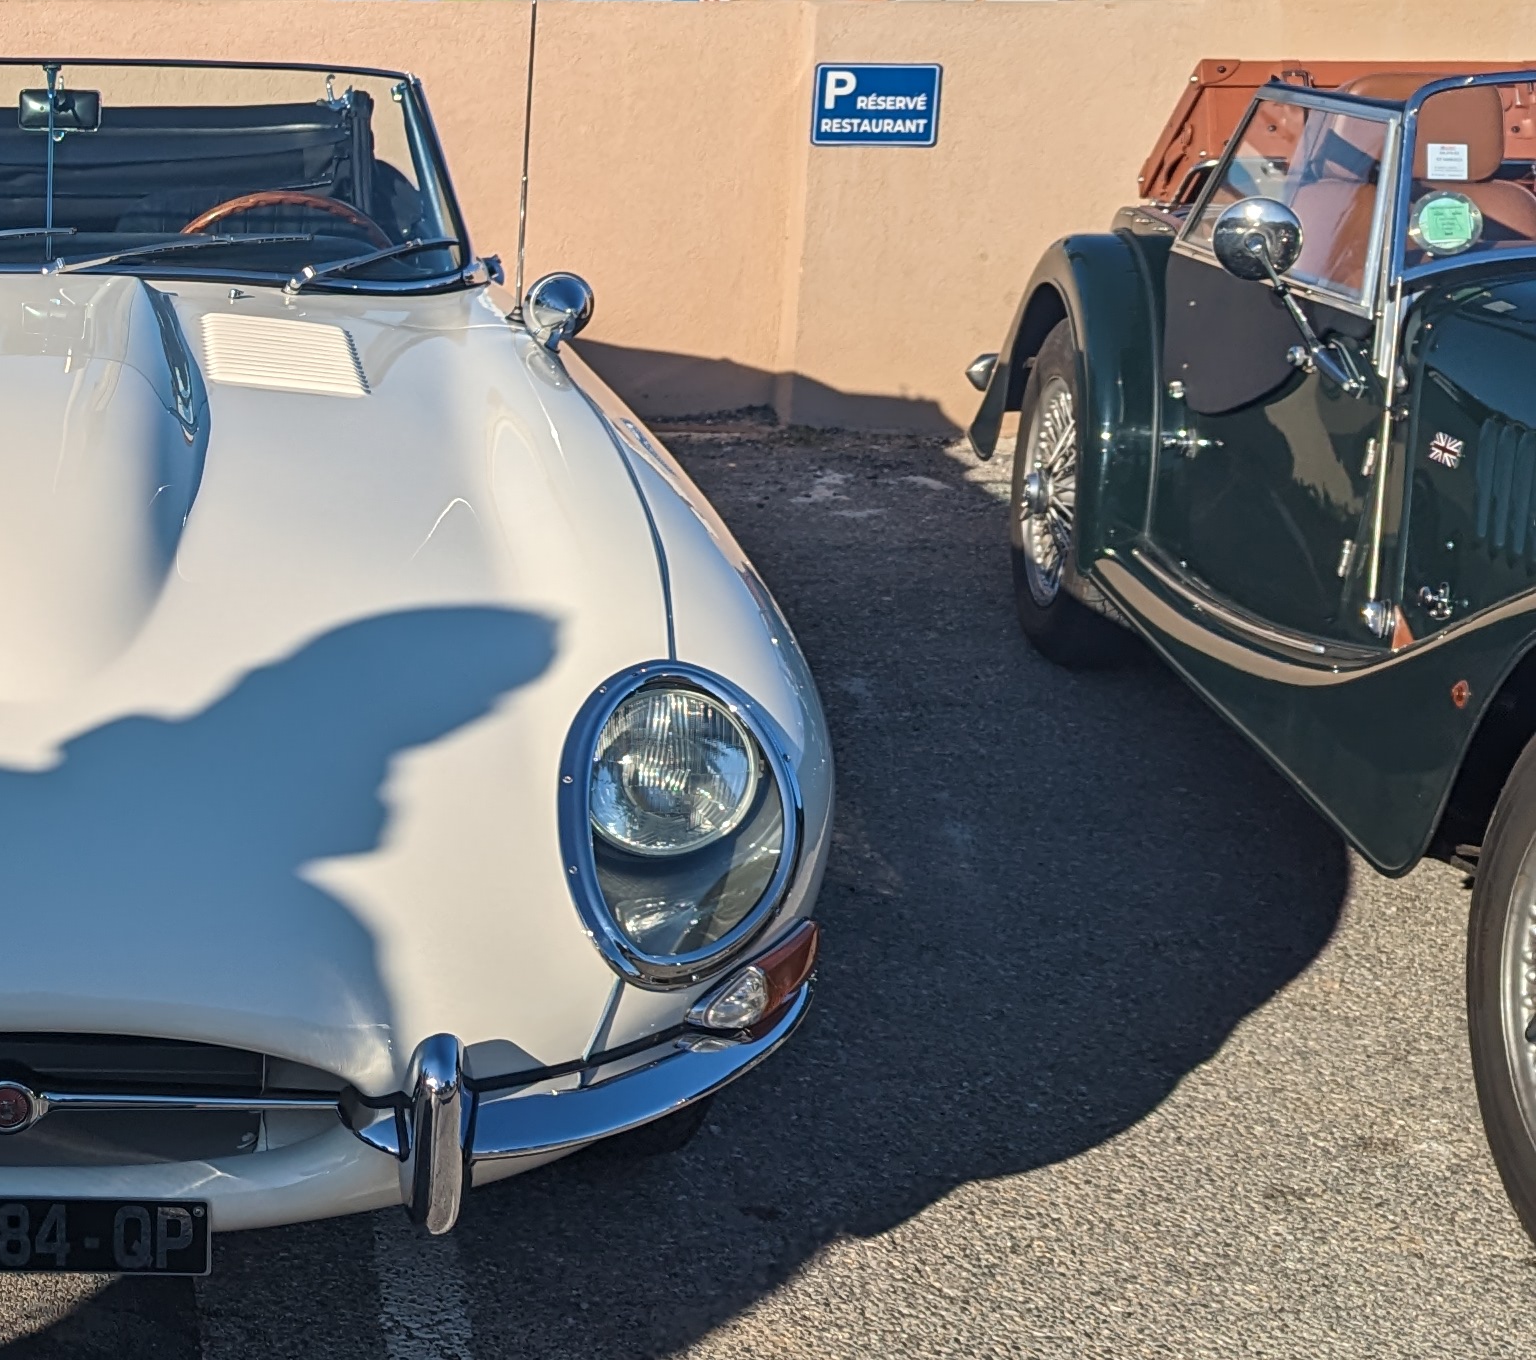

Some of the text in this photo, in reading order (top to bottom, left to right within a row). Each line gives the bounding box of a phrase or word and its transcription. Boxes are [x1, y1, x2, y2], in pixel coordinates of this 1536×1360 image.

[824, 70, 928, 110] P RÉSERVÉ
[820, 118, 928, 134] RESTAURANT
